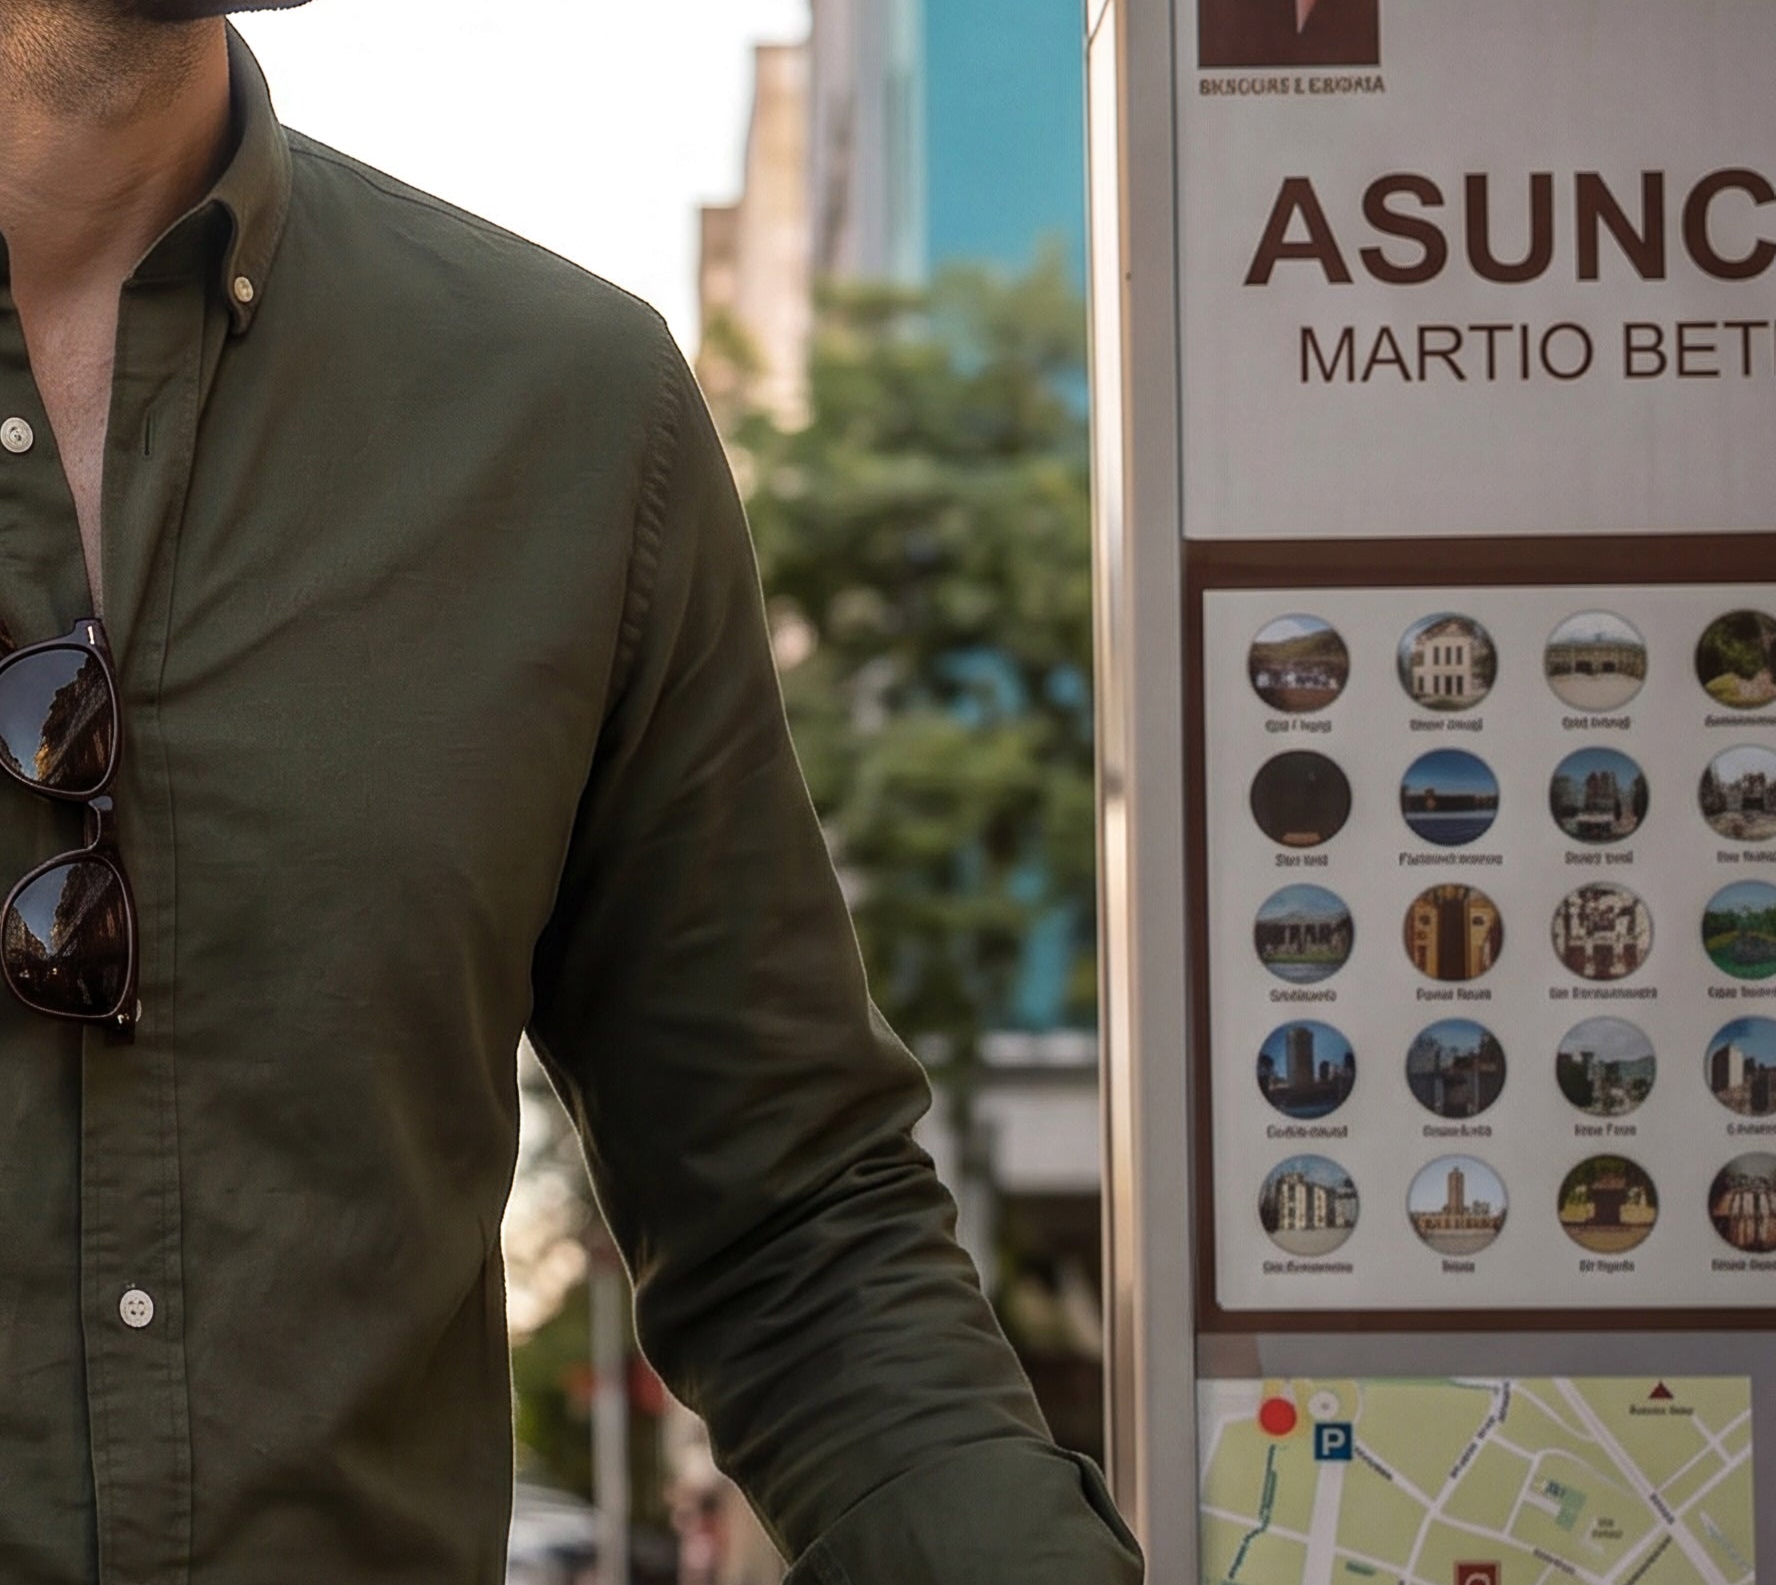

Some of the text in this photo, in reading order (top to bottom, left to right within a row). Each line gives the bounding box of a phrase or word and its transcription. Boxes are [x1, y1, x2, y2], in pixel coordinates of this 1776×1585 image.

[1243, 167, 1776, 287] ASUNC
[1300, 320, 1776, 383] MARTIO BET
